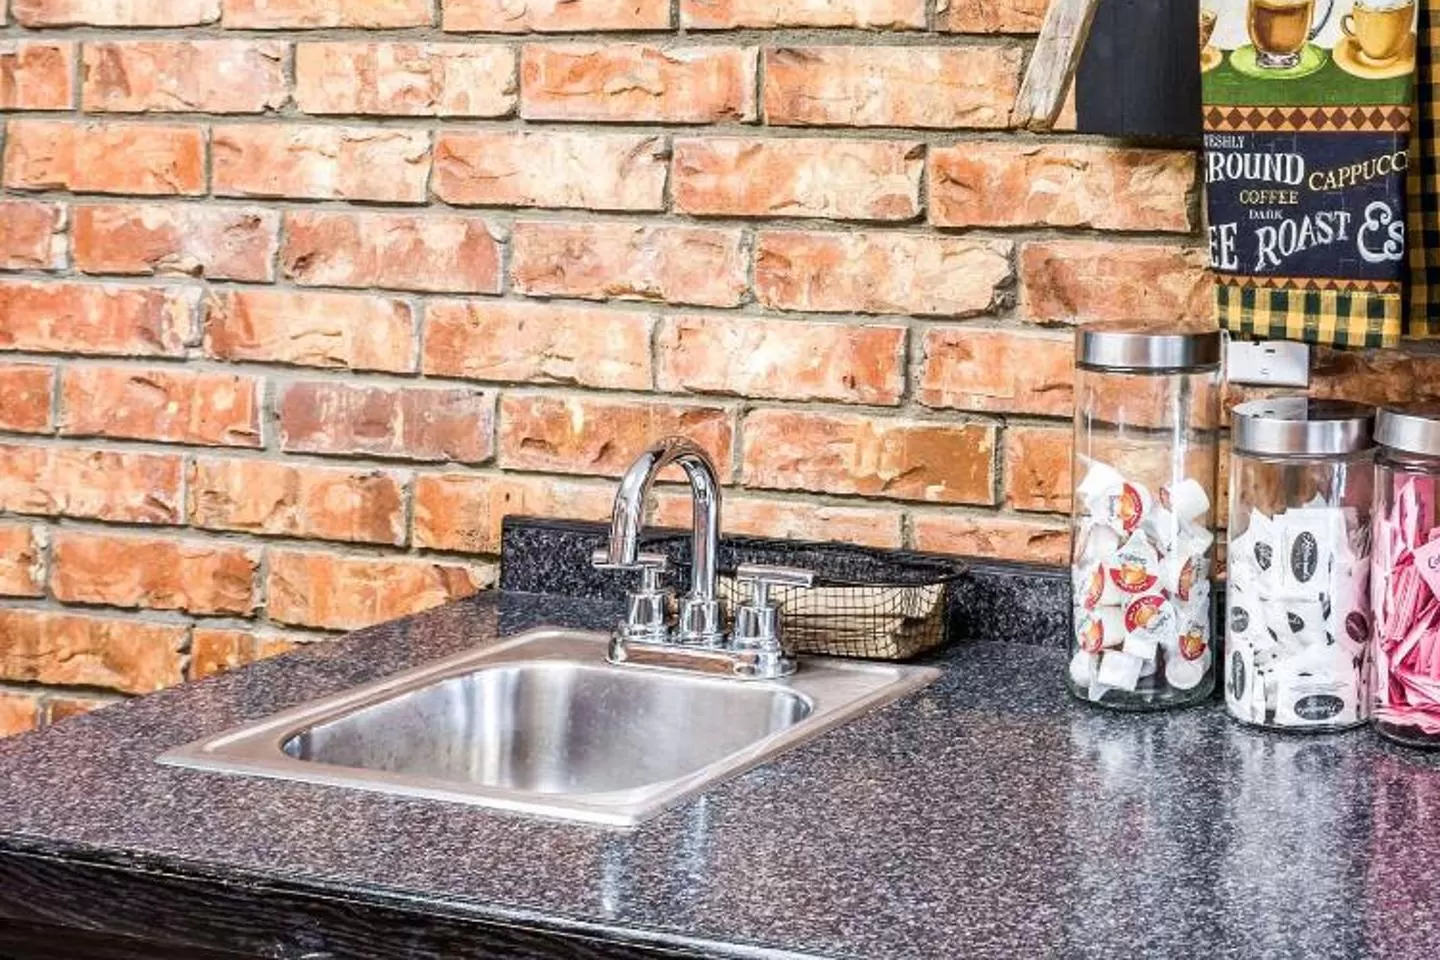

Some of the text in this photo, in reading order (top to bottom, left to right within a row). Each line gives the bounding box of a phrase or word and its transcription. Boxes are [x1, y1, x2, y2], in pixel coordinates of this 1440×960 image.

[1205, 151, 1304, 185] ROUND
[1239, 190, 1299, 205] COFFEE
[1249, 208, 1284, 220] DARK
[1254, 210, 1351, 272] ROAST
